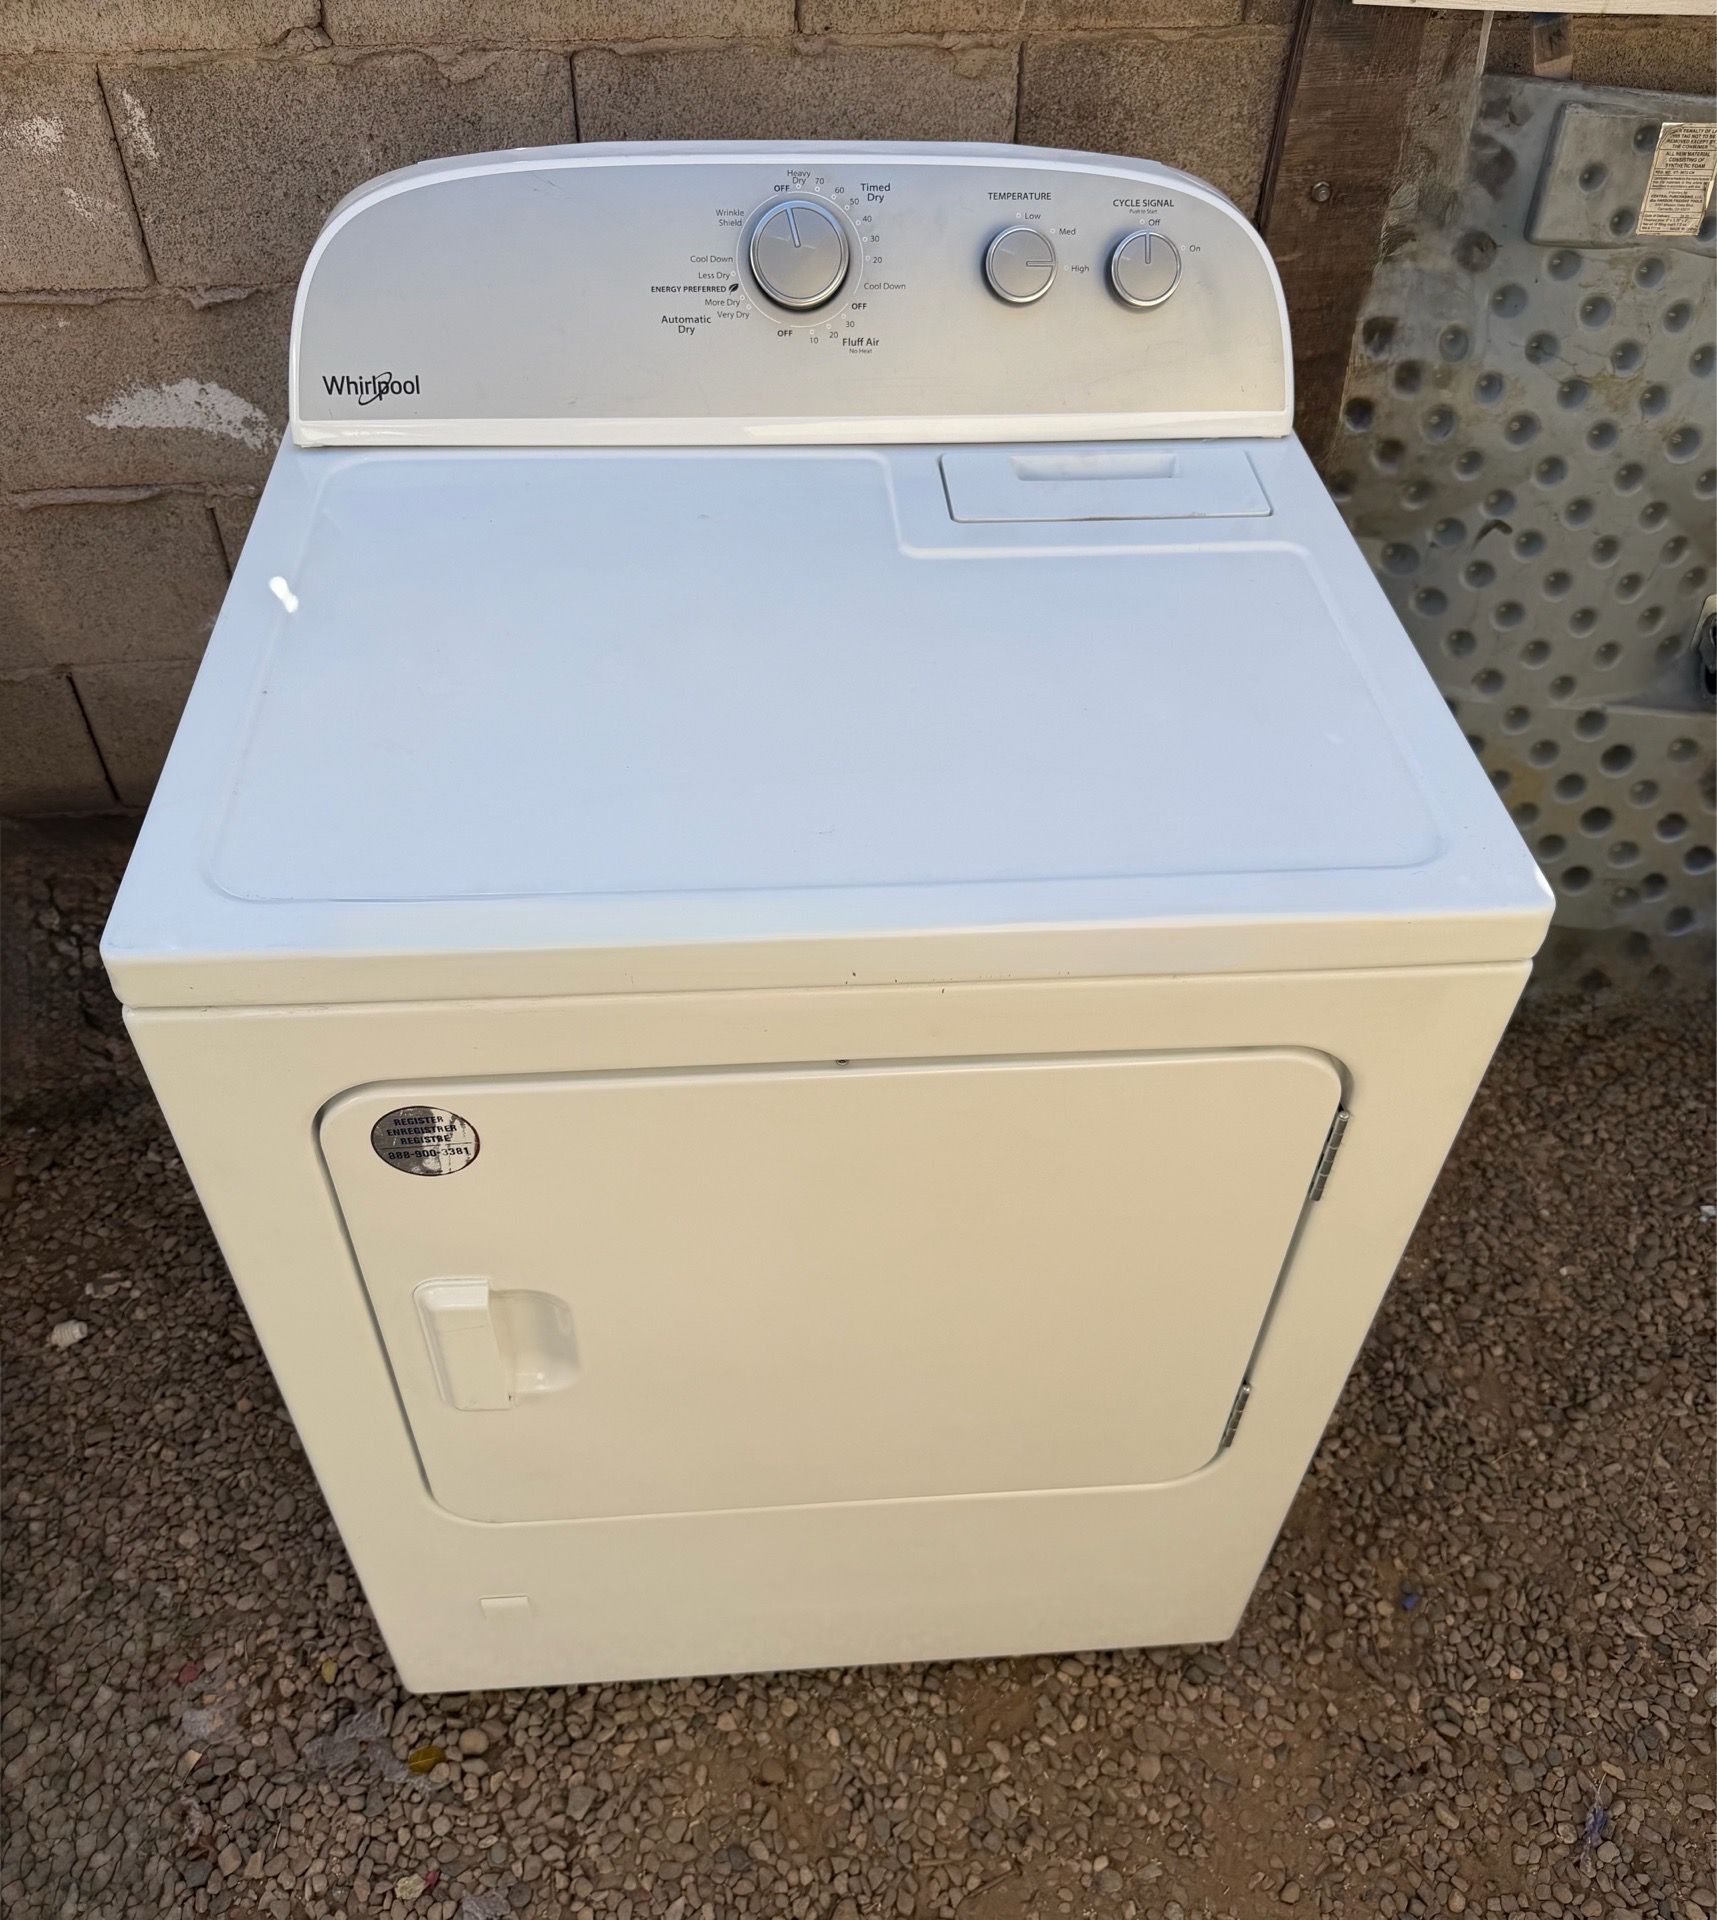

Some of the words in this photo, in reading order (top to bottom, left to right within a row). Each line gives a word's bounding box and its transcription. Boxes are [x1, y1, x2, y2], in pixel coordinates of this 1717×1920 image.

[787, 169, 811, 178] Heavy
[861, 183, 890, 192] Timed
[867, 193, 885, 203] Dry
[988, 192, 1051, 200] TEMPERATURE
[1112, 199, 1141, 207] CYCLE
[1143, 199, 1174, 208] SIGNAL
[1024, 212, 1041, 220] Low
[1059, 228, 1076, 236] Med
[1071, 264, 1090, 273] High
[716, 272, 730, 281] Dry
[727, 299, 740, 308] Dry
[661, 315, 711, 324] Automatic
[717, 311, 735, 320] Very
[736, 311, 750, 320] Dry
[678, 325, 695, 335] Dry
[842, 338, 864, 346] Fluff
[866, 338, 880, 346] Air
[322, 372, 420, 406] Whirlpool
[394, 1116, 444, 1126] REGISTER
[386, 1125, 457, 1136] ENREGISTRER
[388, 1147, 470, 1160] 888-900-3381
